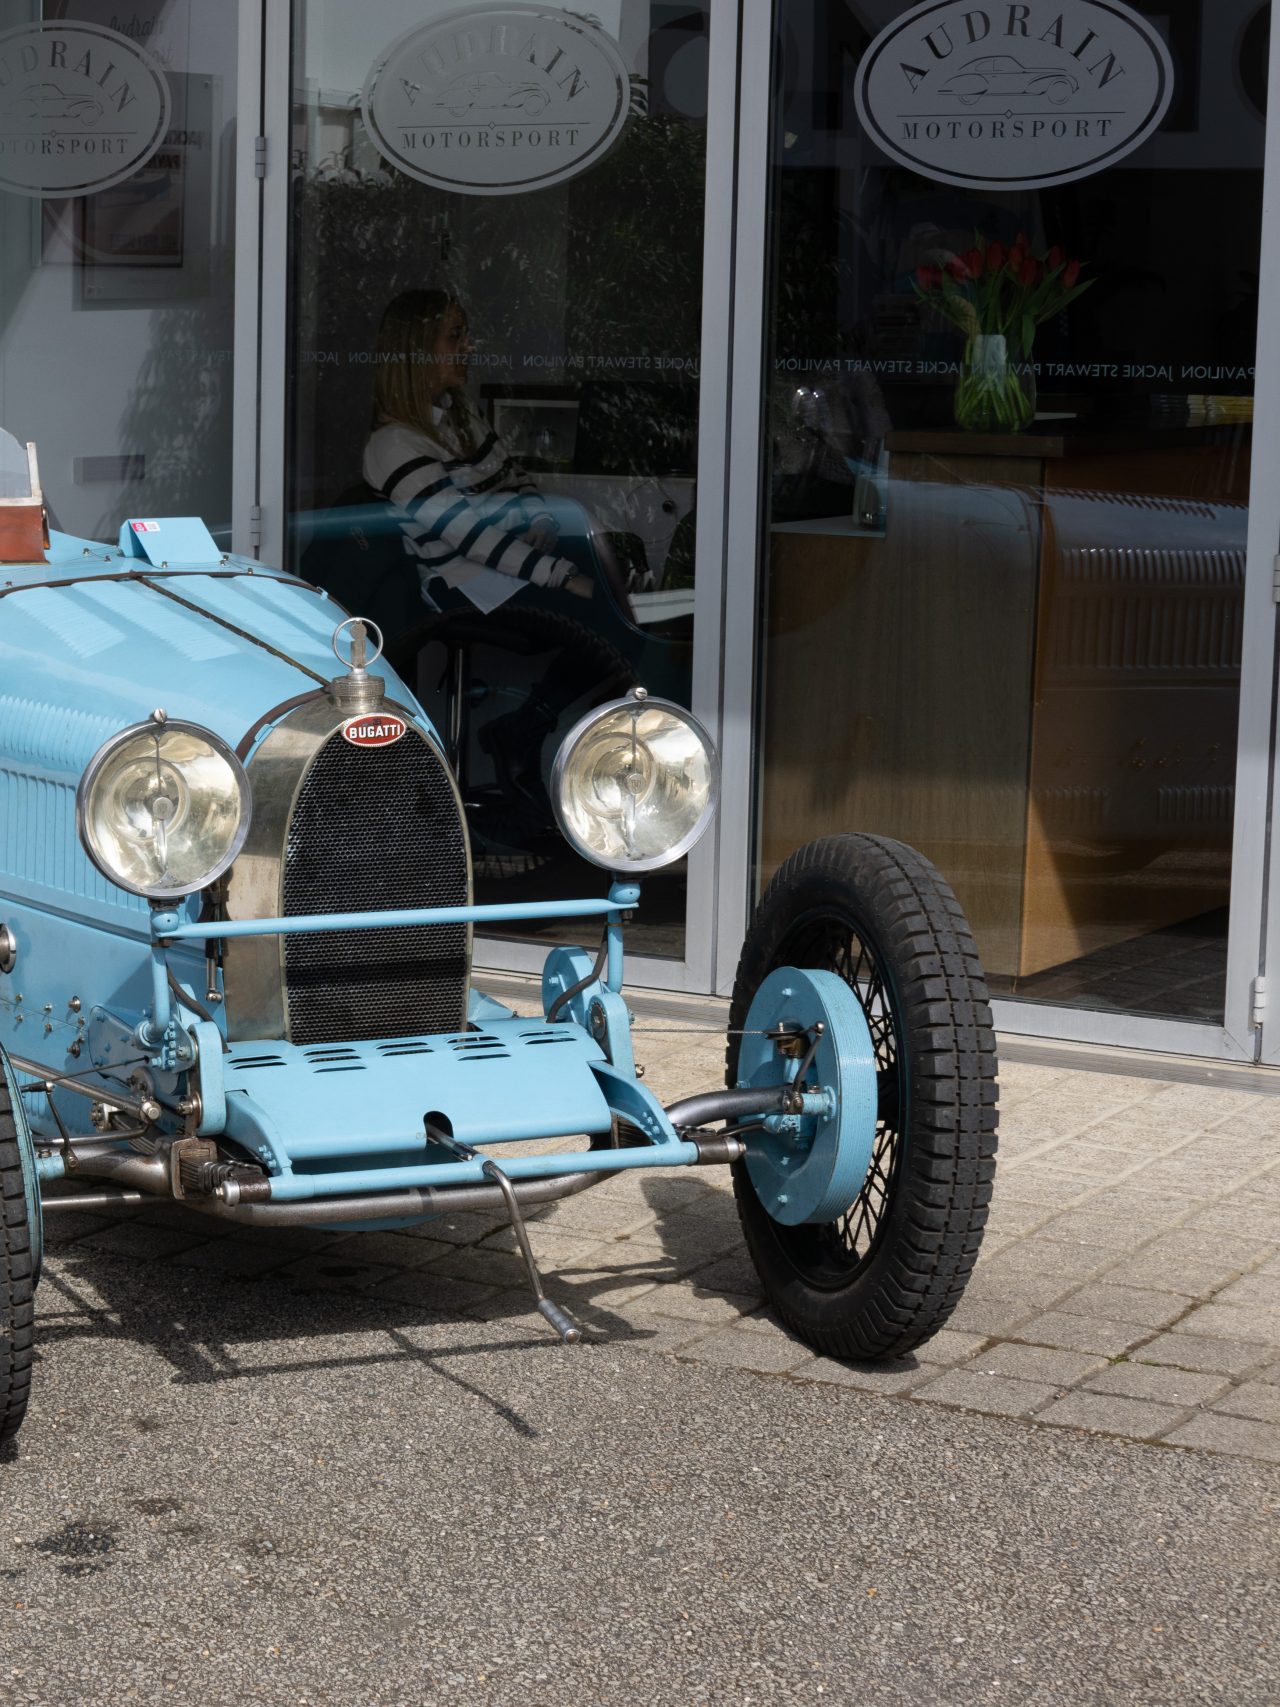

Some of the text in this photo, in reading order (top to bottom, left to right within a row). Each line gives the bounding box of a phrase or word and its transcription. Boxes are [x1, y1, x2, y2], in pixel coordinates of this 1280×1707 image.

[899, 4, 1126, 94] AUDRAIN
[902, 119, 1112, 139] MOTORSPORT
[403, 130, 579, 149] MOTORSPORT
[349, 724, 400, 739] BUGATTI
